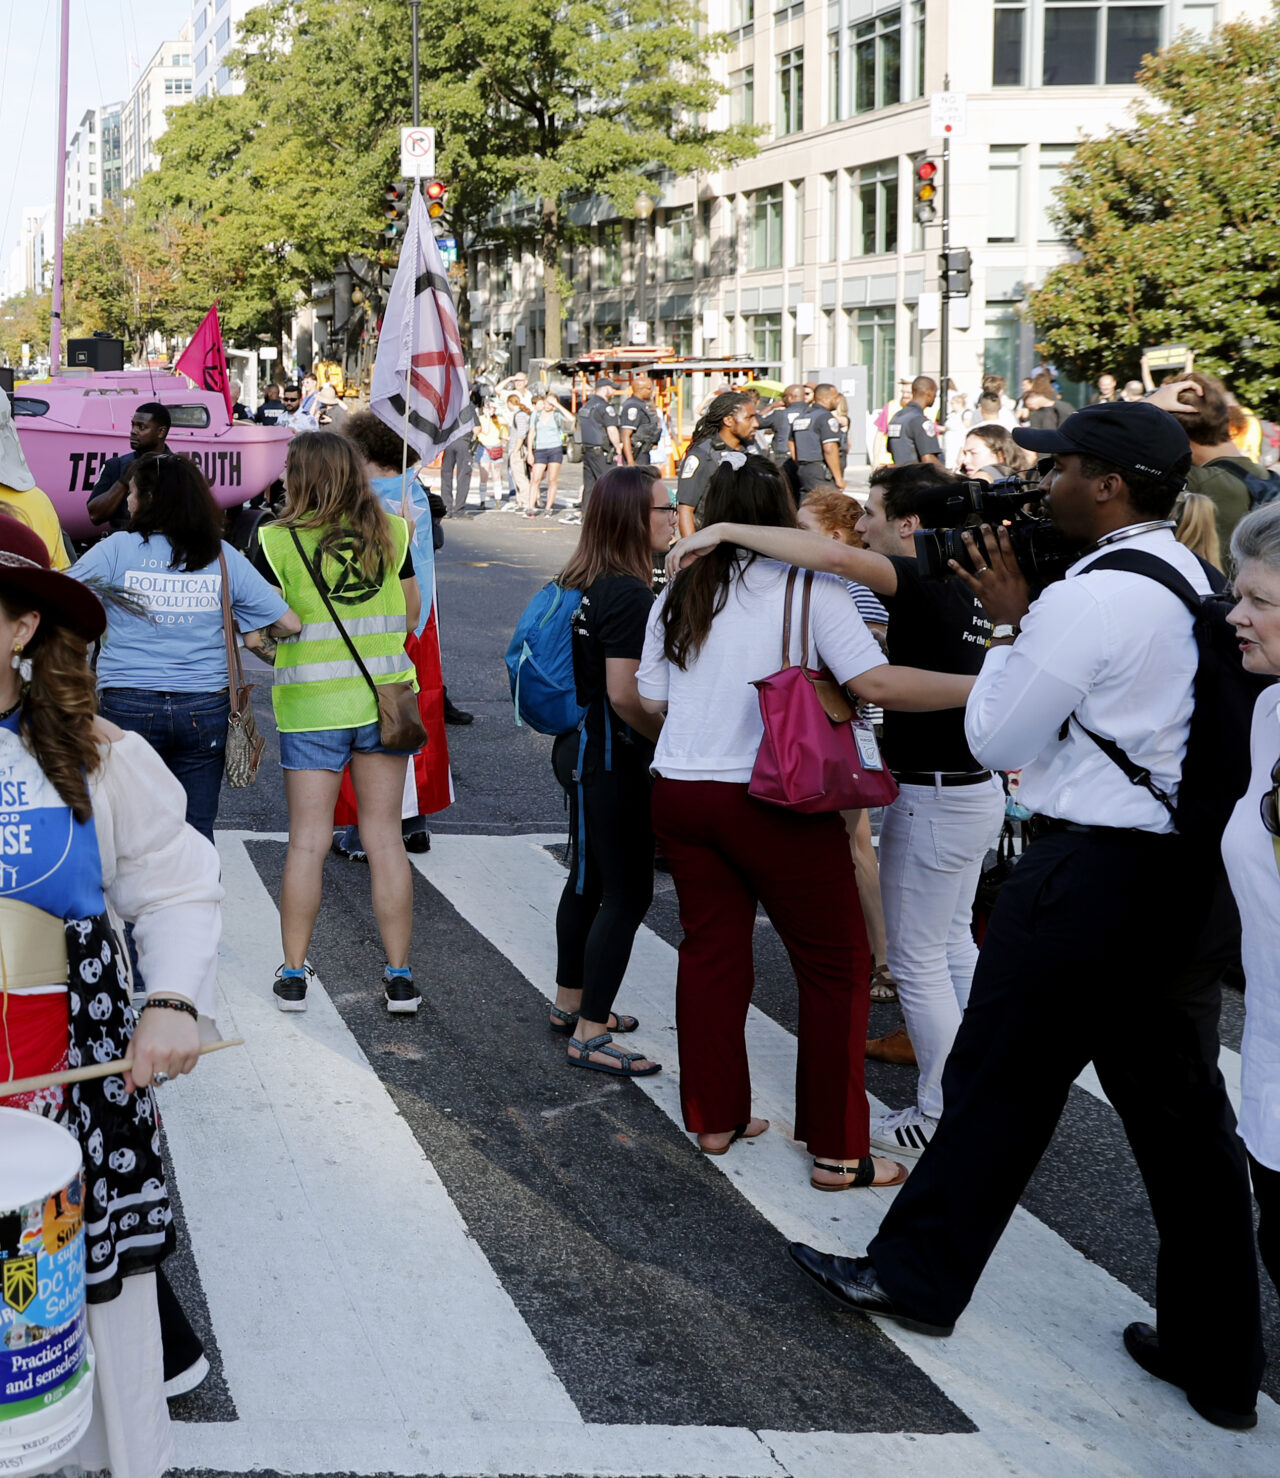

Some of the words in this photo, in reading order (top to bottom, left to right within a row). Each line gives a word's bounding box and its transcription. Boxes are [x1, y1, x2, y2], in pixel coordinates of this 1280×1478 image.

[69, 451, 119, 493] TE
[128, 594, 220, 608] EVOLUTION
[962, 631, 976, 643] For
[38, 1271, 65, 1300] DC
[11, 1343, 62, 1373] Practice
[5, 1372, 33, 1394] and
